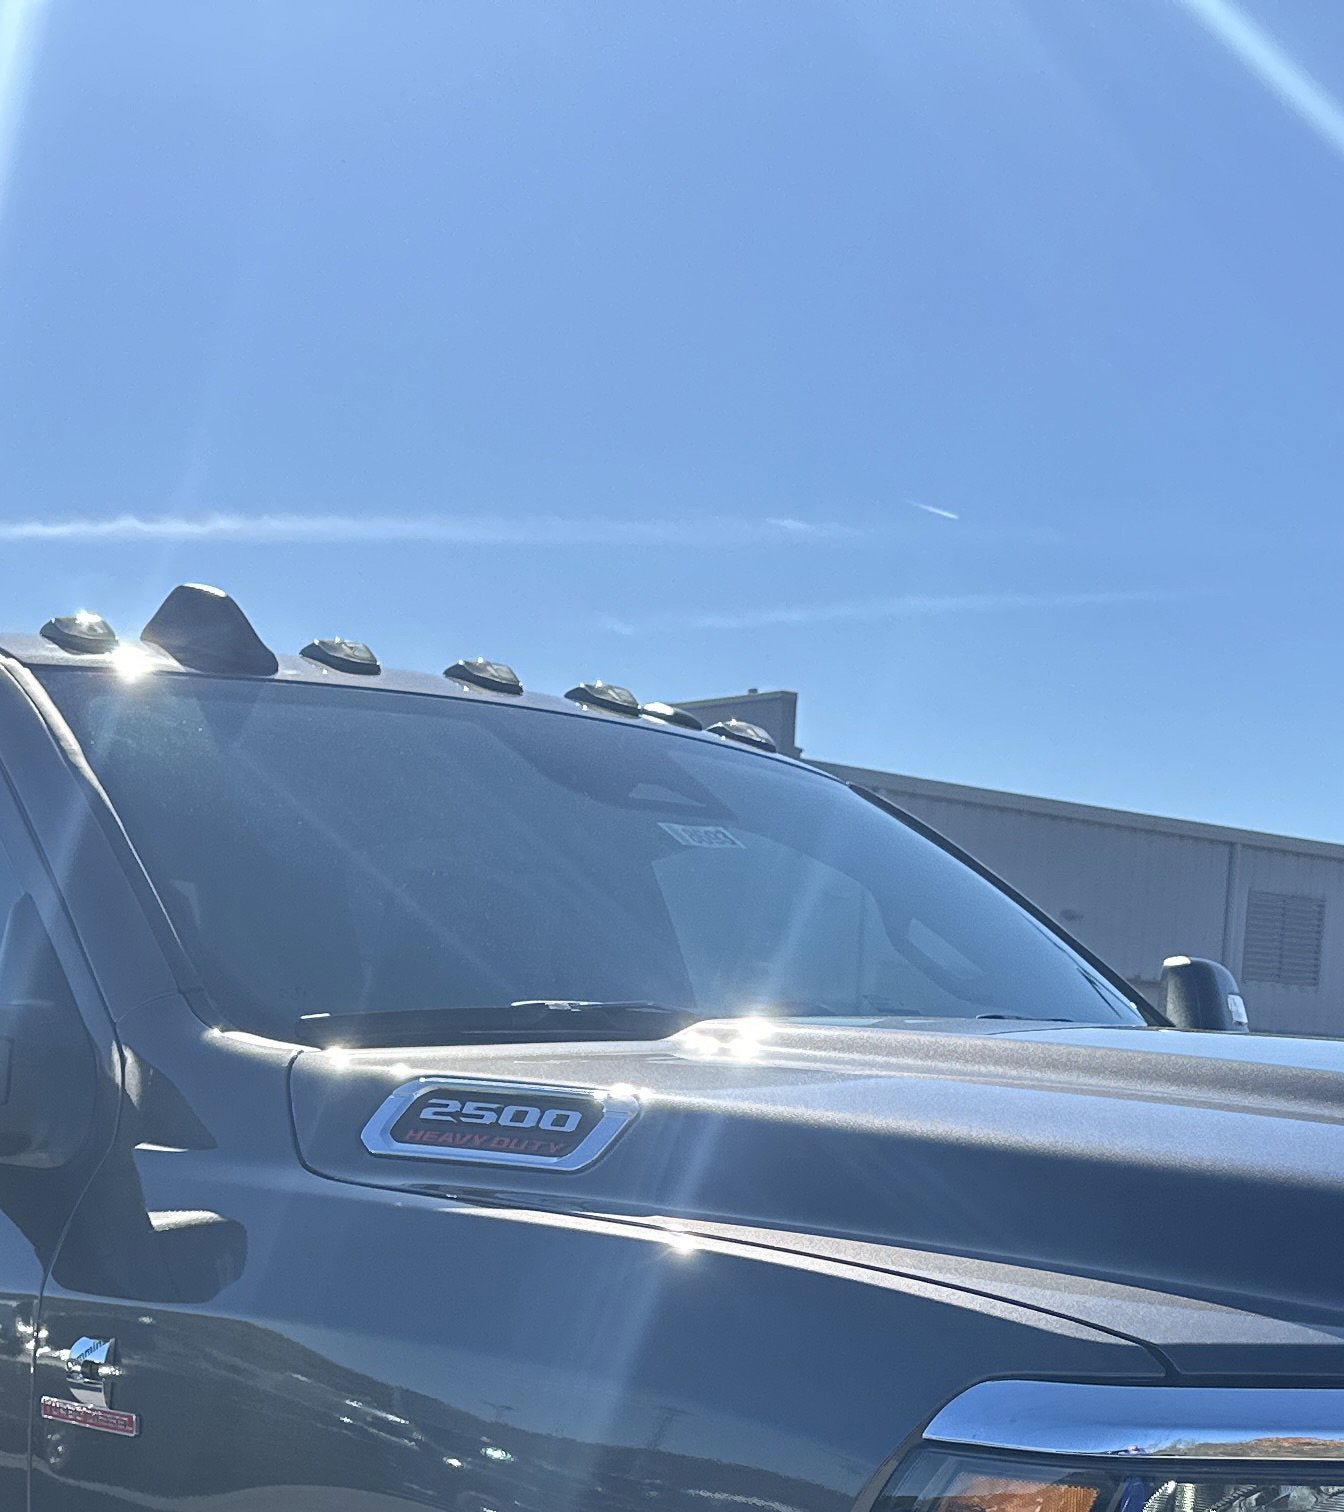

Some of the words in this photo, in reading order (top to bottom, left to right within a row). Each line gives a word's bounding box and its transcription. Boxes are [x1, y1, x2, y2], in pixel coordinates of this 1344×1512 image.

[419, 1099, 583, 1133] 2500
[407, 1130, 489, 1148] HEAVY
[493, 1136, 565, 1153] DUTY
